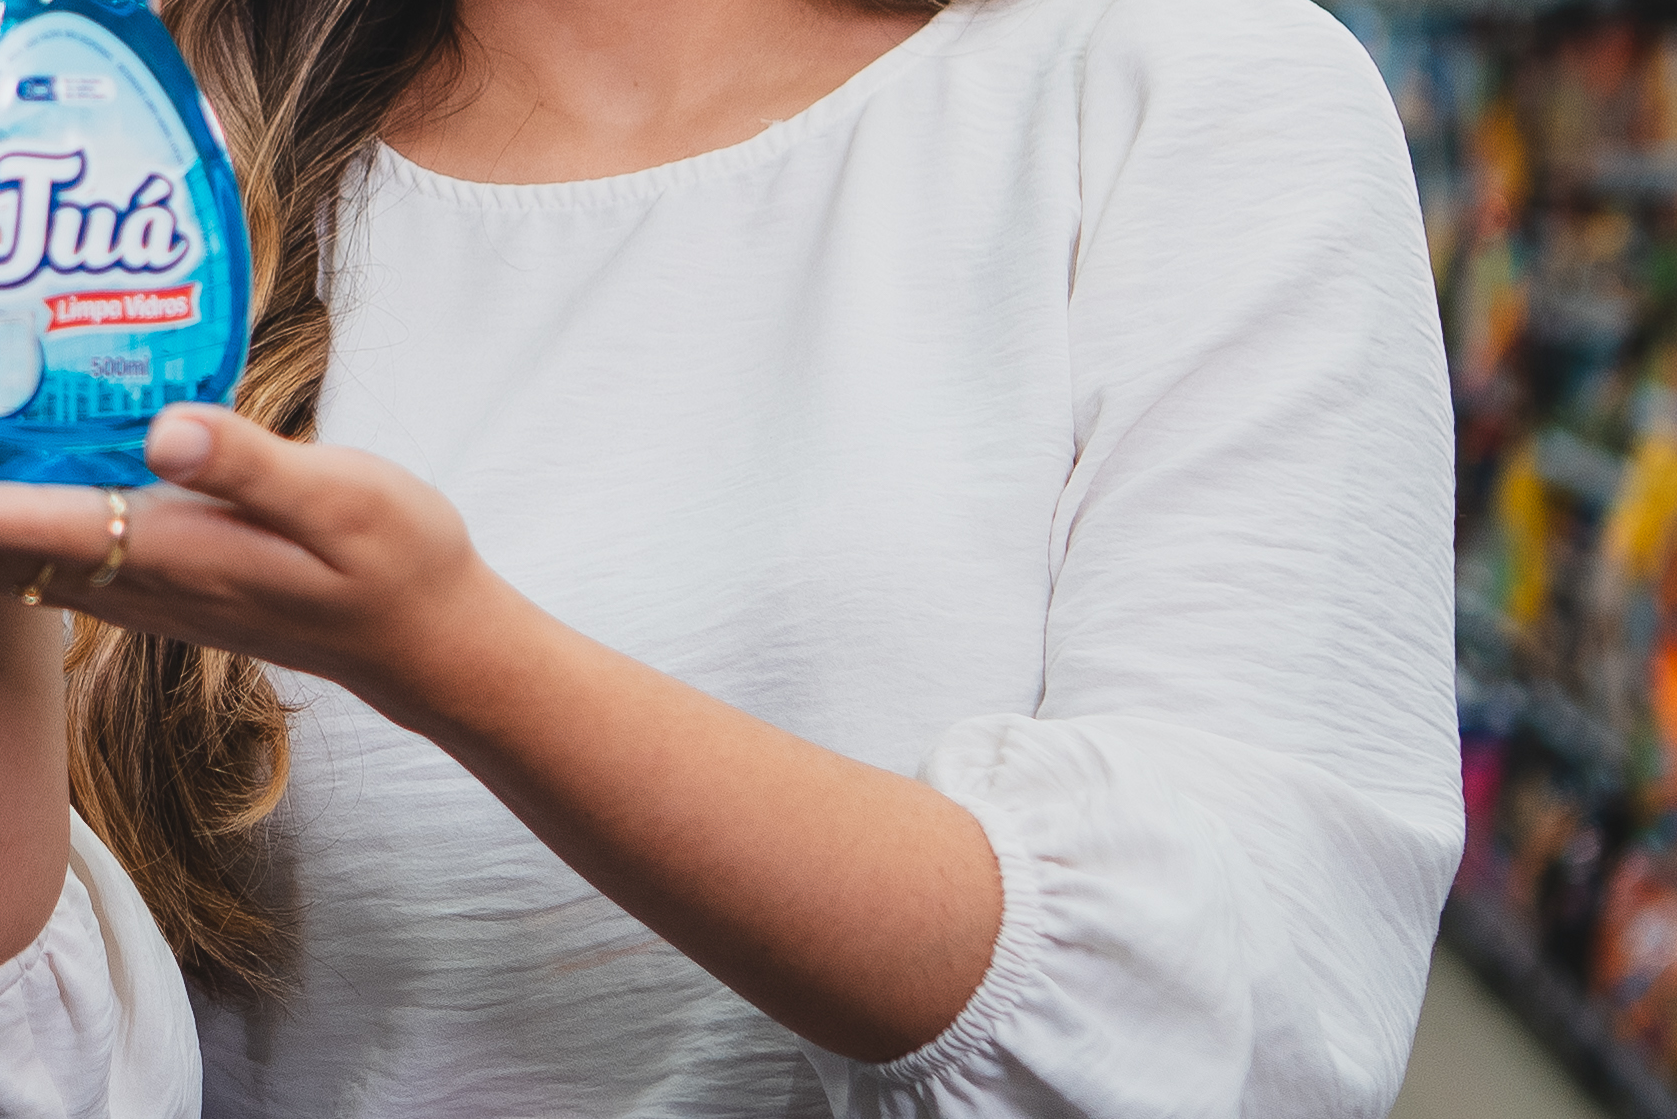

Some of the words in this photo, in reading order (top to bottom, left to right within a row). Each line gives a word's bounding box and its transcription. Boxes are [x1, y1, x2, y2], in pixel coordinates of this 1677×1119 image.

[57, 294, 122, 325] Limpa
[123, 293, 190, 319] Vidros
[92, 356, 150, 377] 500ml
